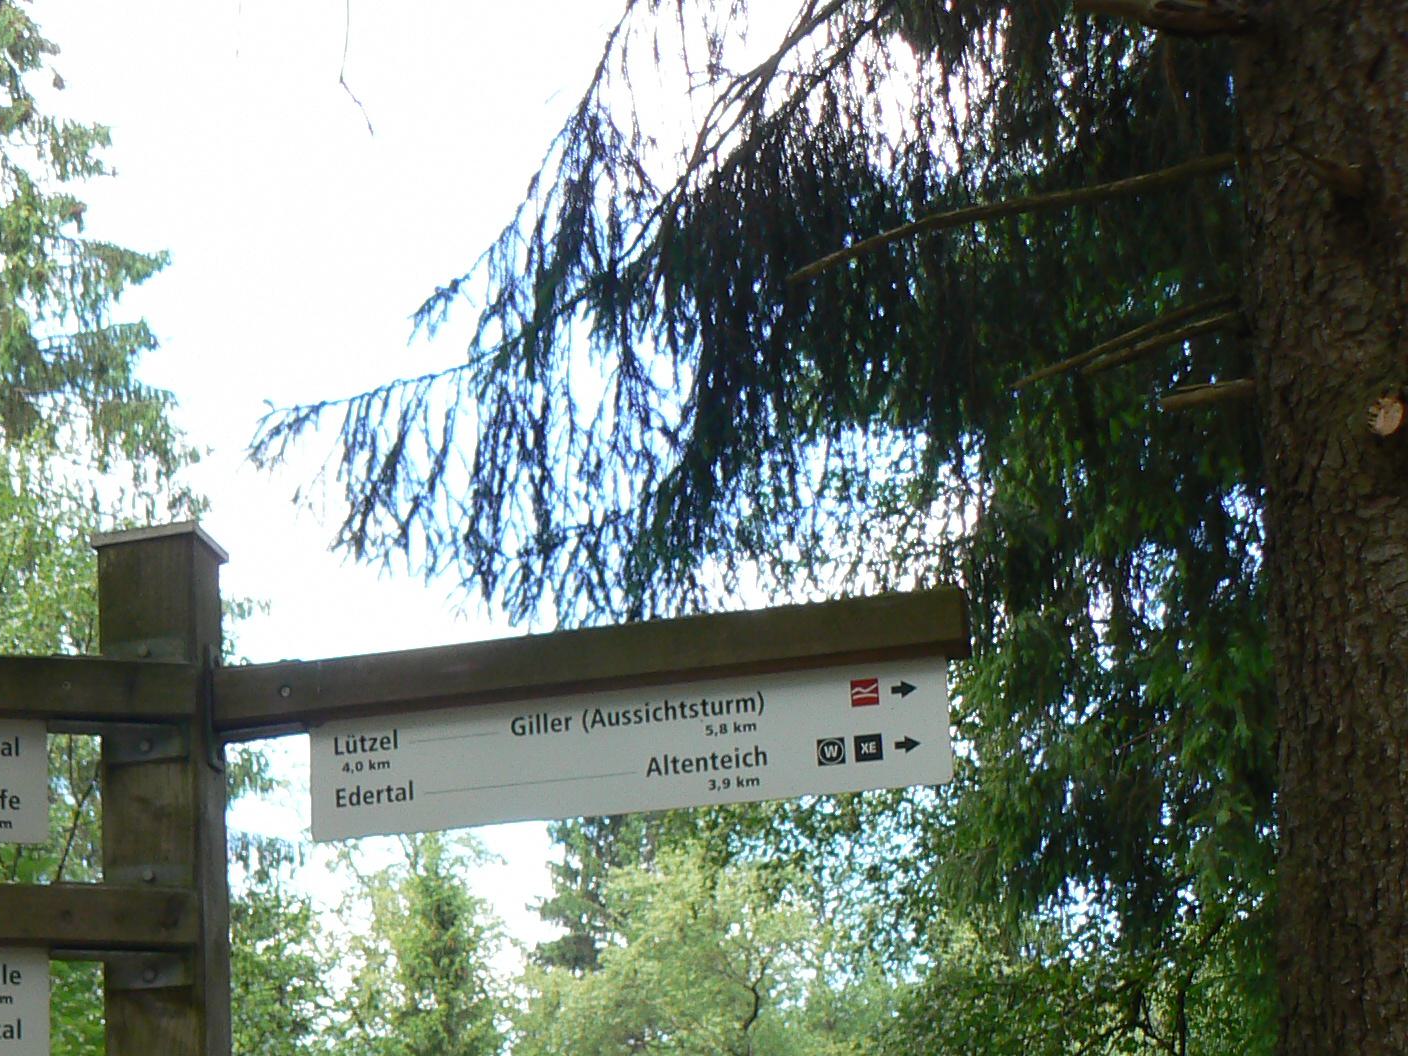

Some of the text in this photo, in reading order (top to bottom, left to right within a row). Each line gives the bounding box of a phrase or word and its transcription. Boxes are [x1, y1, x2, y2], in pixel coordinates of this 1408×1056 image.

[511, 691, 765, 737] Giller (Aussichtsturm)
[705, 721, 757, 737] 5,8 km
[334, 729, 399, 756] Lützel
[860, 742, 878, 755] XE
[342, 758, 390, 774] 4,0 km
[646, 745, 768, 777] Altenteich
[708, 775, 760, 791] 3,9 km
[336, 780, 414, 808] Edertal
